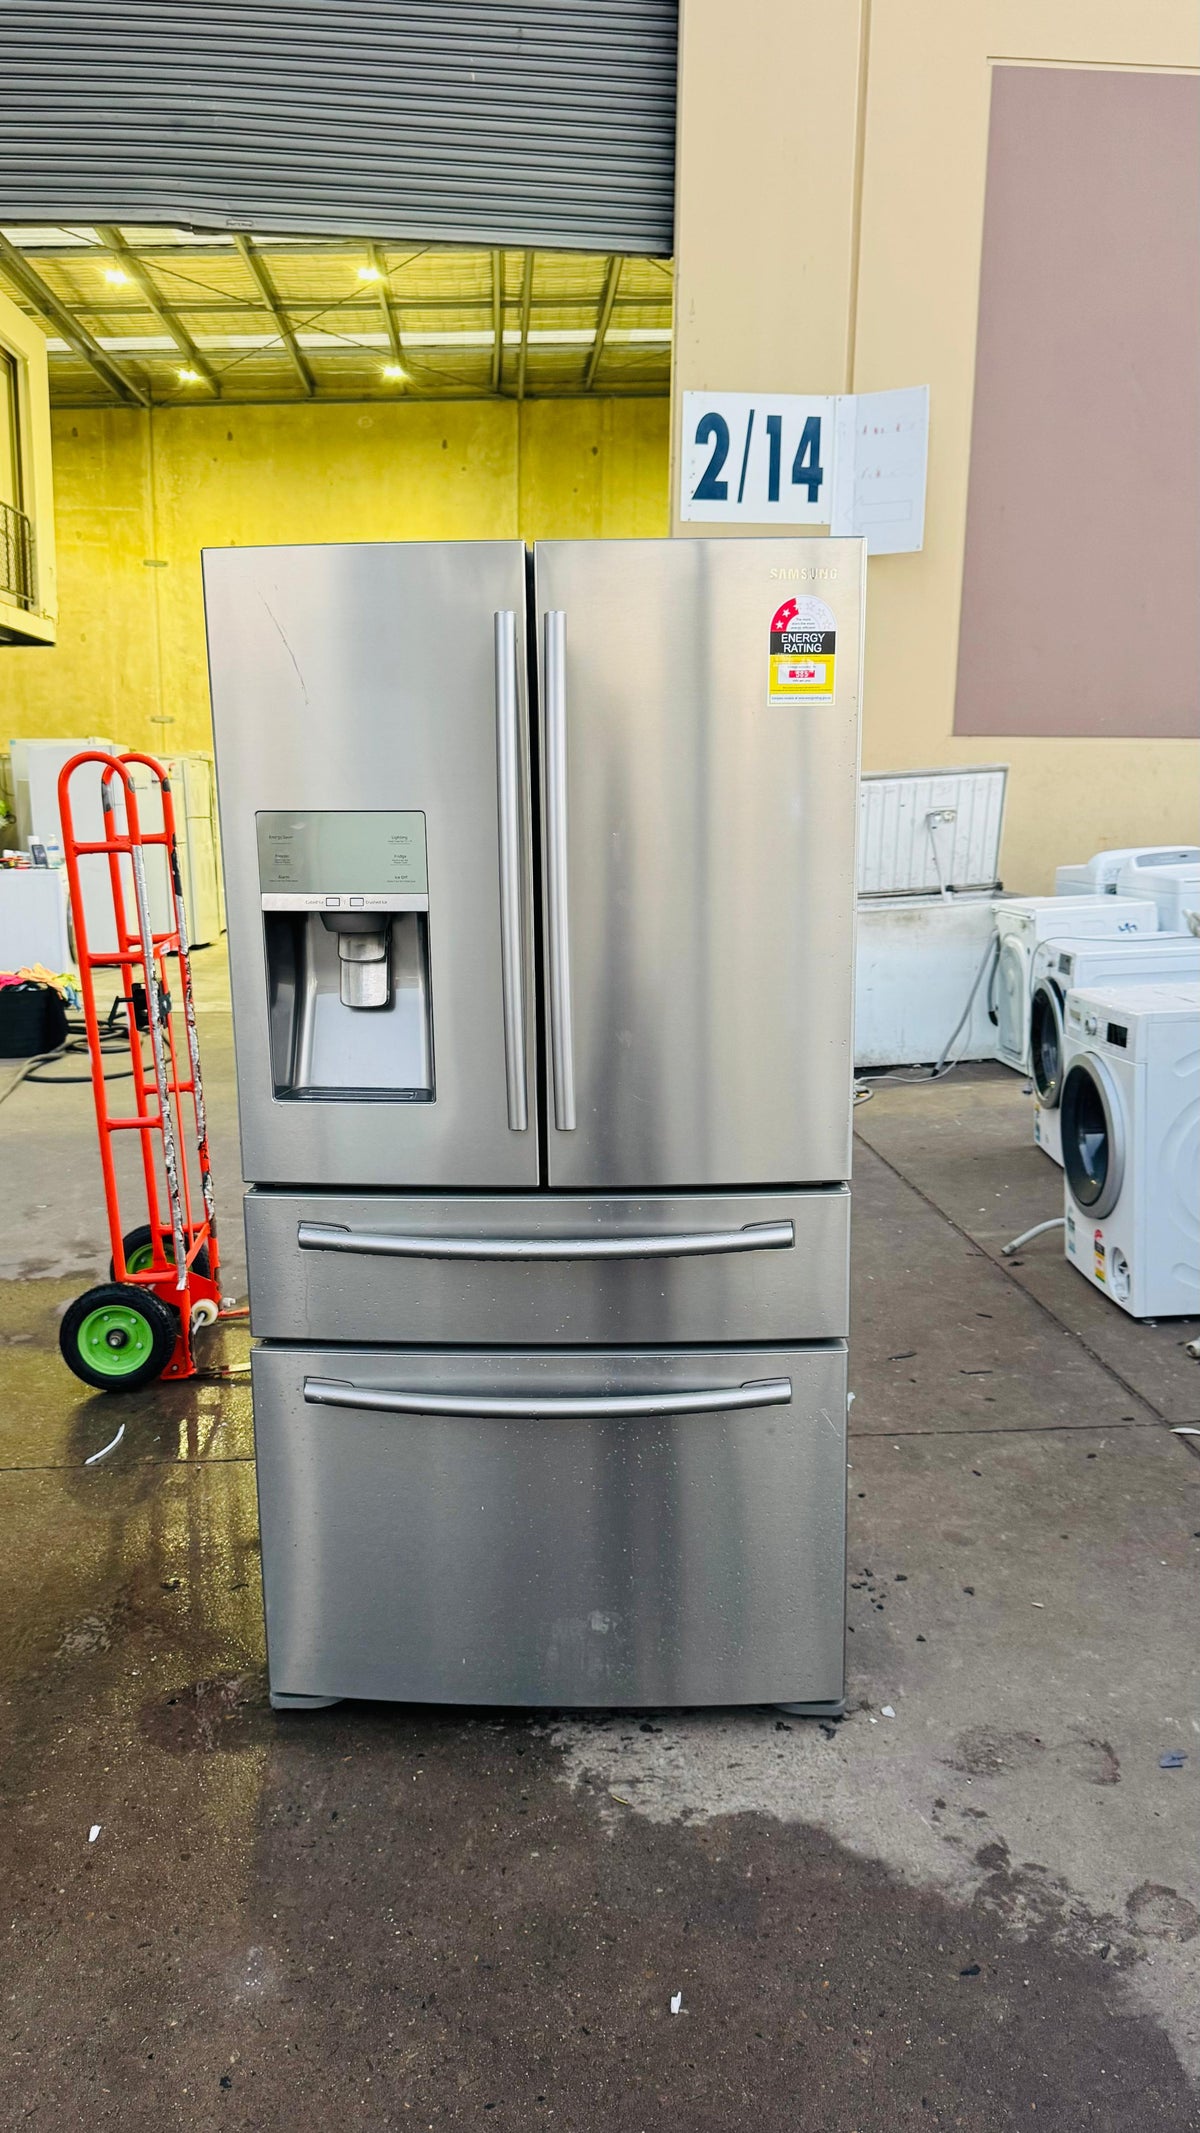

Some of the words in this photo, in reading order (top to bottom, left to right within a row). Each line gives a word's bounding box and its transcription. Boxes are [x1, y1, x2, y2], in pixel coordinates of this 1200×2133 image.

[691, 409, 823, 503] 2/14
[769, 568, 837, 580] SAMSUNG
[781, 633, 826, 643] ENERGY
[783, 643, 823, 653] RATING
